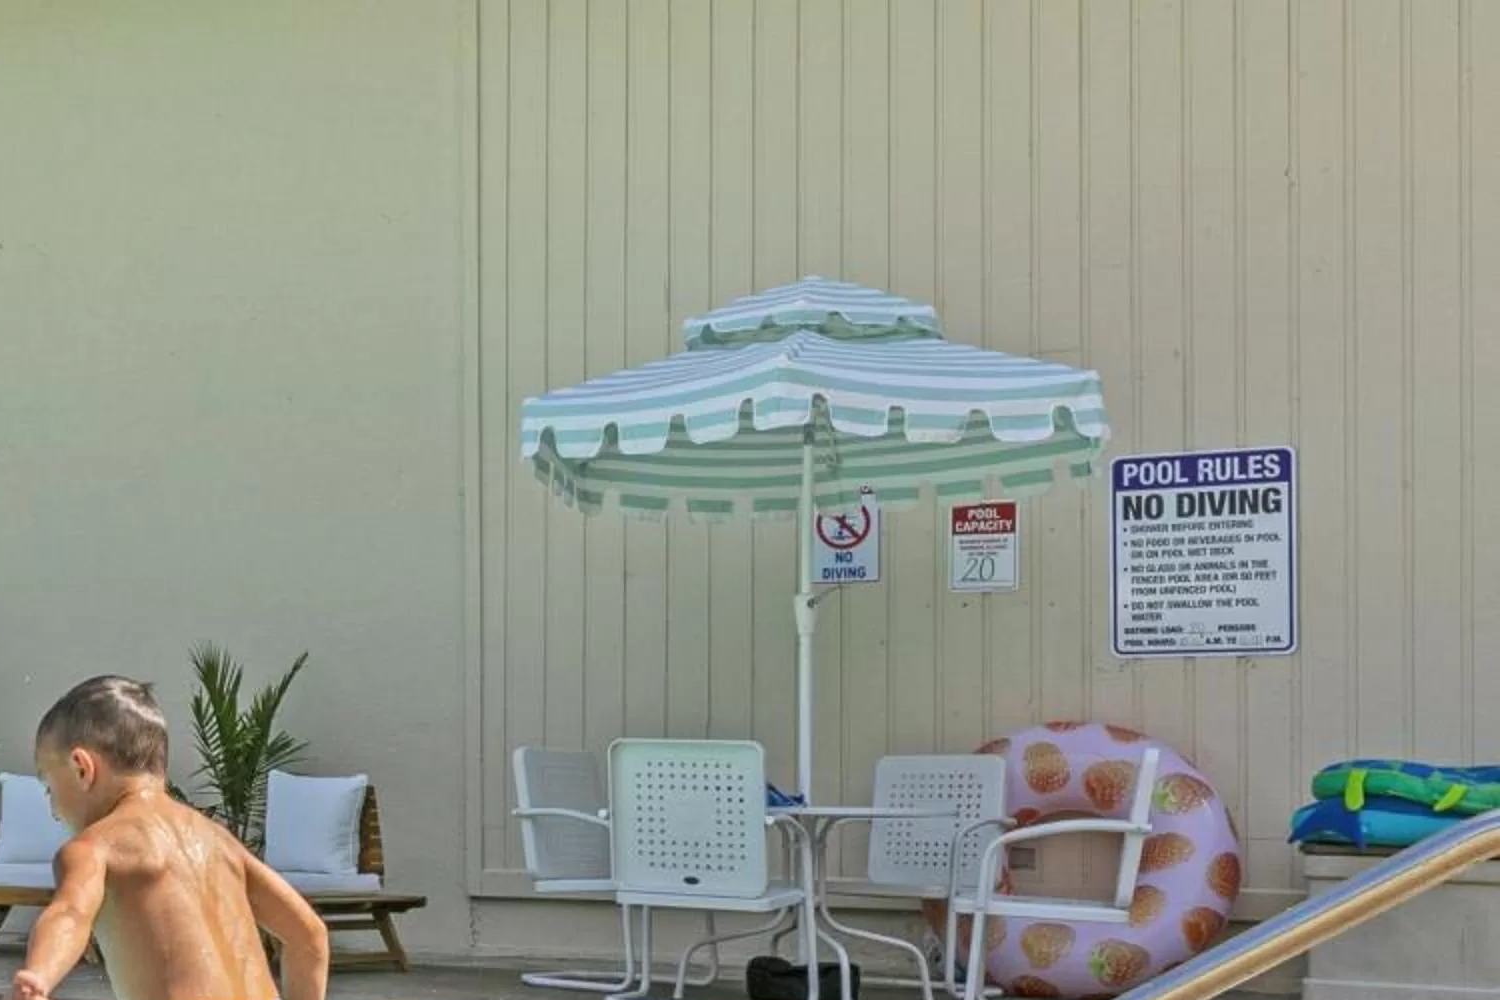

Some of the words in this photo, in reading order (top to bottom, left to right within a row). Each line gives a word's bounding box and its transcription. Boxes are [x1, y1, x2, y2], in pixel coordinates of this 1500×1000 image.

[1122, 458, 1188, 487] POOL
[1197, 453, 1281, 483] RULES
[1122, 493, 1165, 521] NO
[1176, 487, 1282, 518] DIVING
[967, 506, 1001, 519] POOL
[955, 519, 1013, 533] CAPACITY
[1209, 519, 1254, 531] ENTERING
[1130, 539, 1144, 548] NO
[1146, 538, 1169, 547] FOOD
[1172, 536, 1185, 546] OR
[1188, 533, 1242, 545] BEVERAGES
[1257, 532, 1281, 542] POOL
[835, 552, 853, 564] NO
[1162, 548, 1184, 558] POOL
[961, 556, 996, 583] 20
[1131, 564, 1144, 573] NO
[1194, 560, 1236, 571] ANIMALS
[1238, 560, 1248, 569] IN
[1251, 559, 1268, 568] THE
[821, 566, 867, 581] DIVING
[1131, 575, 1165, 584] FENCED
[1168, 574, 1192, 583] POOL
[1194, 572, 1219, 582] AREA
[1254, 570, 1277, 580] FEET
[1131, 586, 1157, 596] FROM
[1160, 585, 1207, 595] UNFENCED
[1131, 601, 1145, 611] DO
[1146, 601, 1164, 610] NOT
[1167, 599, 1213, 609] SWALLOW
[1215, 598, 1233, 607] THE
[1235, 597, 1260, 607] POOL
